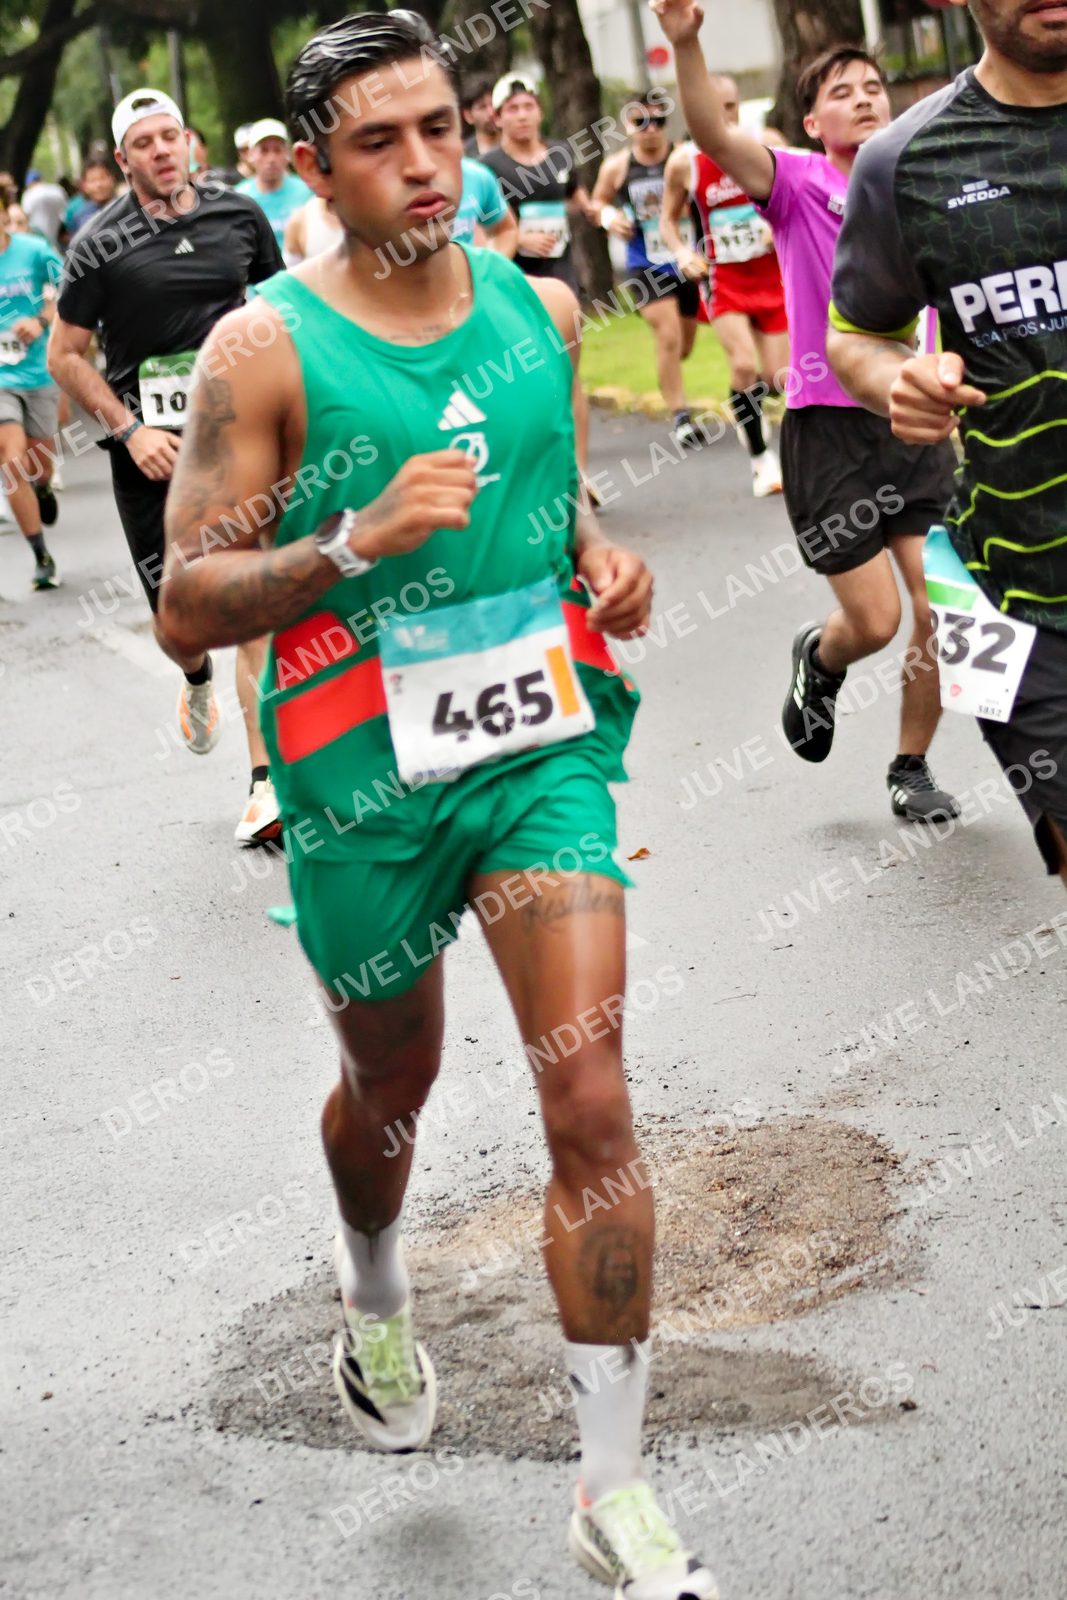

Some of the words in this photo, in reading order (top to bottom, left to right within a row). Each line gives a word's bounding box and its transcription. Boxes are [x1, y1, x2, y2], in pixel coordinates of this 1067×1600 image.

[948, 186, 1011, 209] SVEDDA
[1047, 316, 1067, 332] JU
[931, 609, 1016, 674] 32
[430, 669, 554, 743] 465
